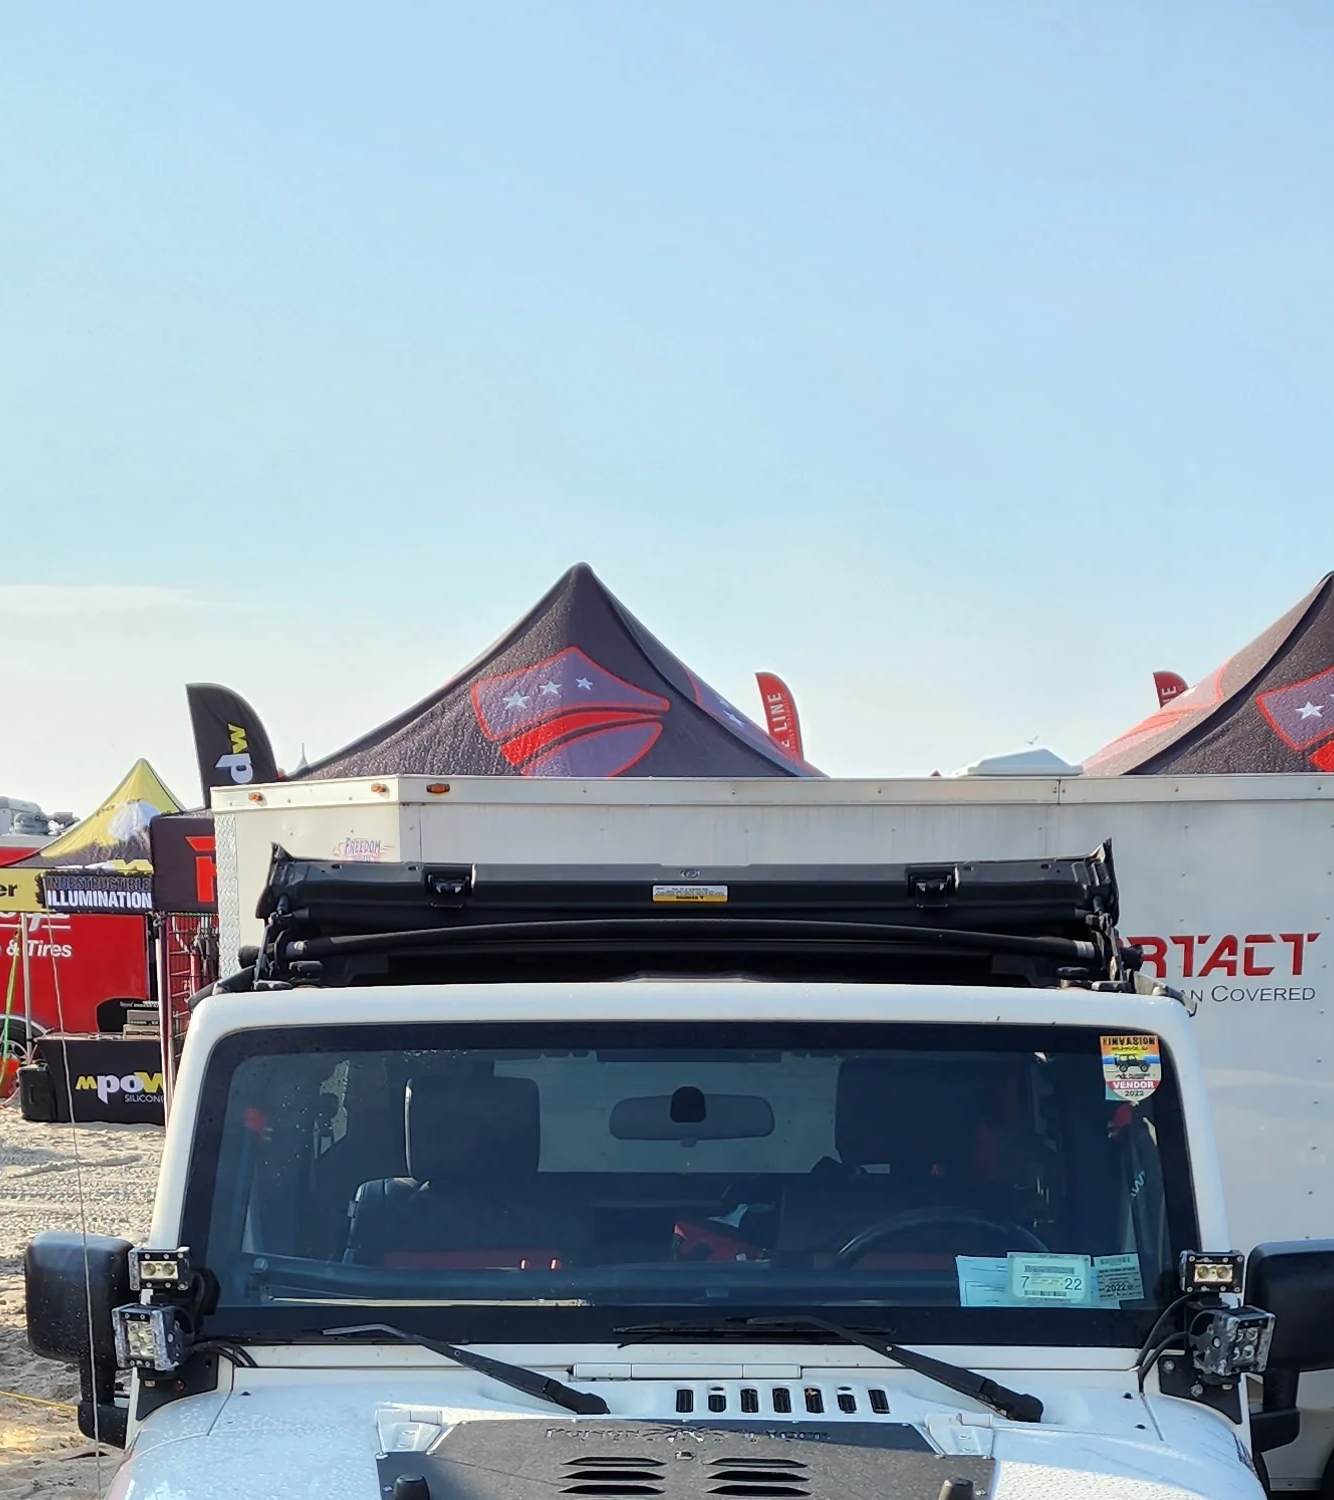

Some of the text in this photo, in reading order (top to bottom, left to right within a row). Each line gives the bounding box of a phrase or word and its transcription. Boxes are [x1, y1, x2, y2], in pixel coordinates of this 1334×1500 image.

[767, 692, 788, 733] LINE
[344, 838, 381, 855] FREEDOM
[46, 891, 153, 909] ILLUMINATION
[27, 939, 73, 958] Tires
[1118, 932, 1321, 979] RTACT
[1113, 1081, 1155, 1089] VENDOR
[1020, 1275, 1030, 1289] 7
[1064, 1277, 1083, 1290] 22
[1105, 1282, 1127, 1292] 2022
